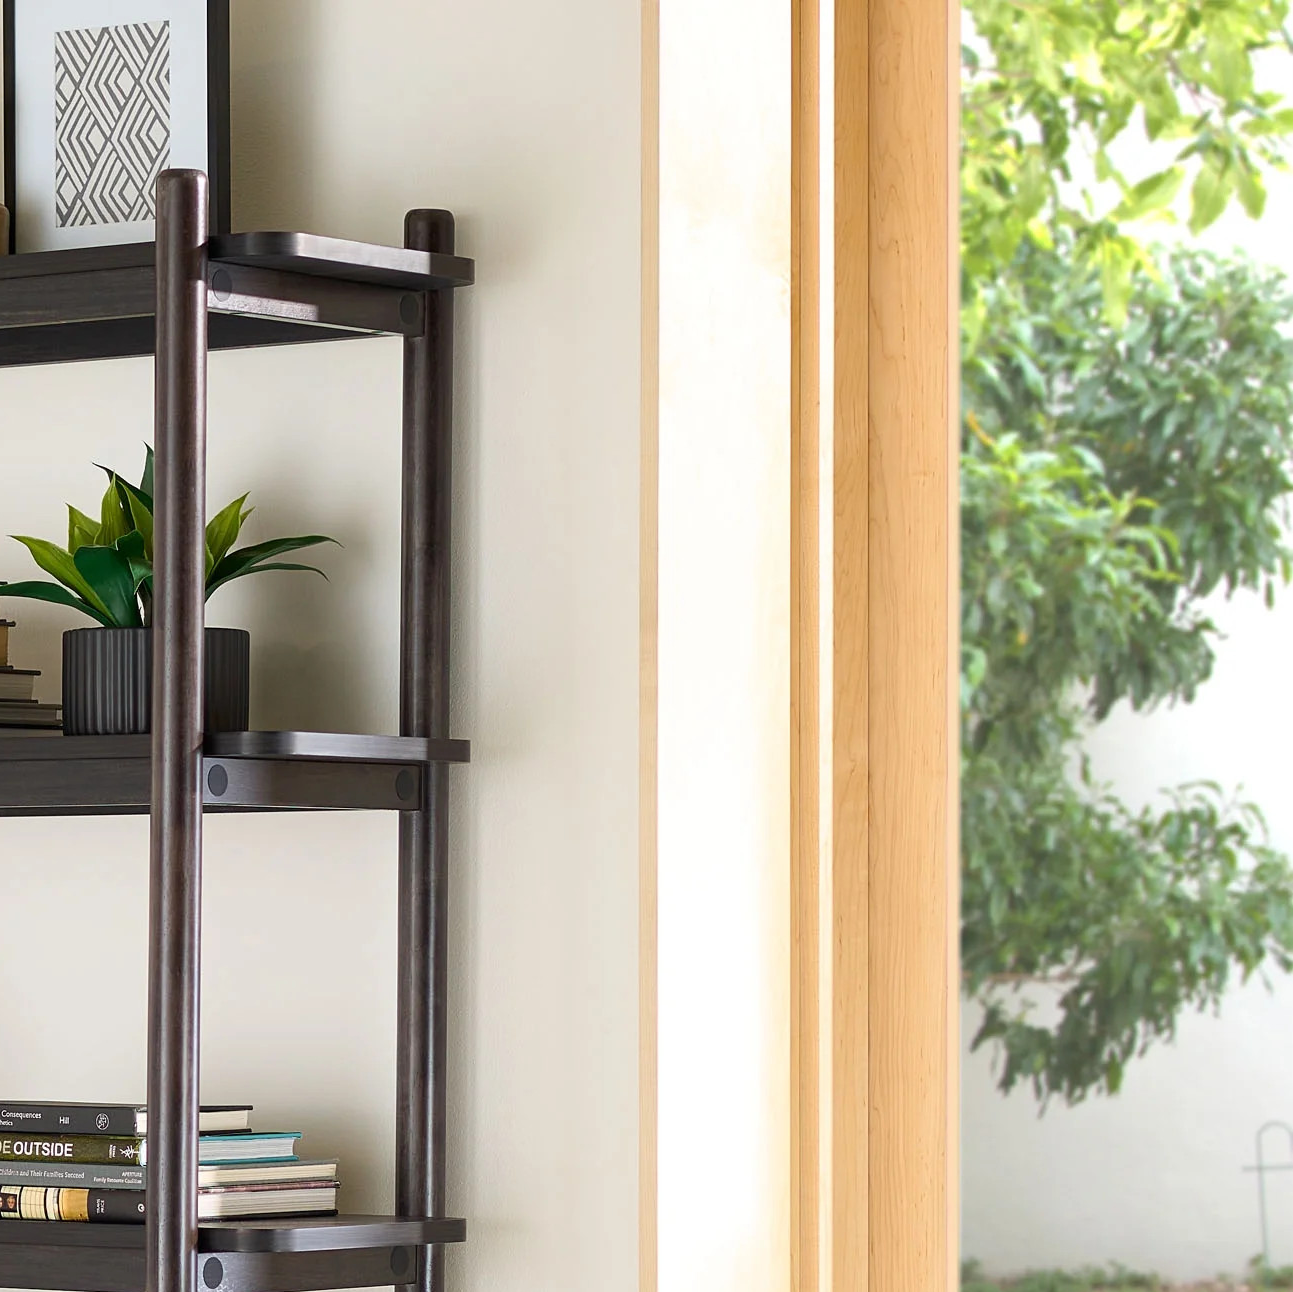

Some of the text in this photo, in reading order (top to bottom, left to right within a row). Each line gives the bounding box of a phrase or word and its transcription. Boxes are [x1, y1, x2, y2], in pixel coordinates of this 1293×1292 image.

[2, 1110, 42, 1119] Consequences
[60, 1116, 70, 1124] Hill
[13, 1141, 74, 1157] OUTSIDE
